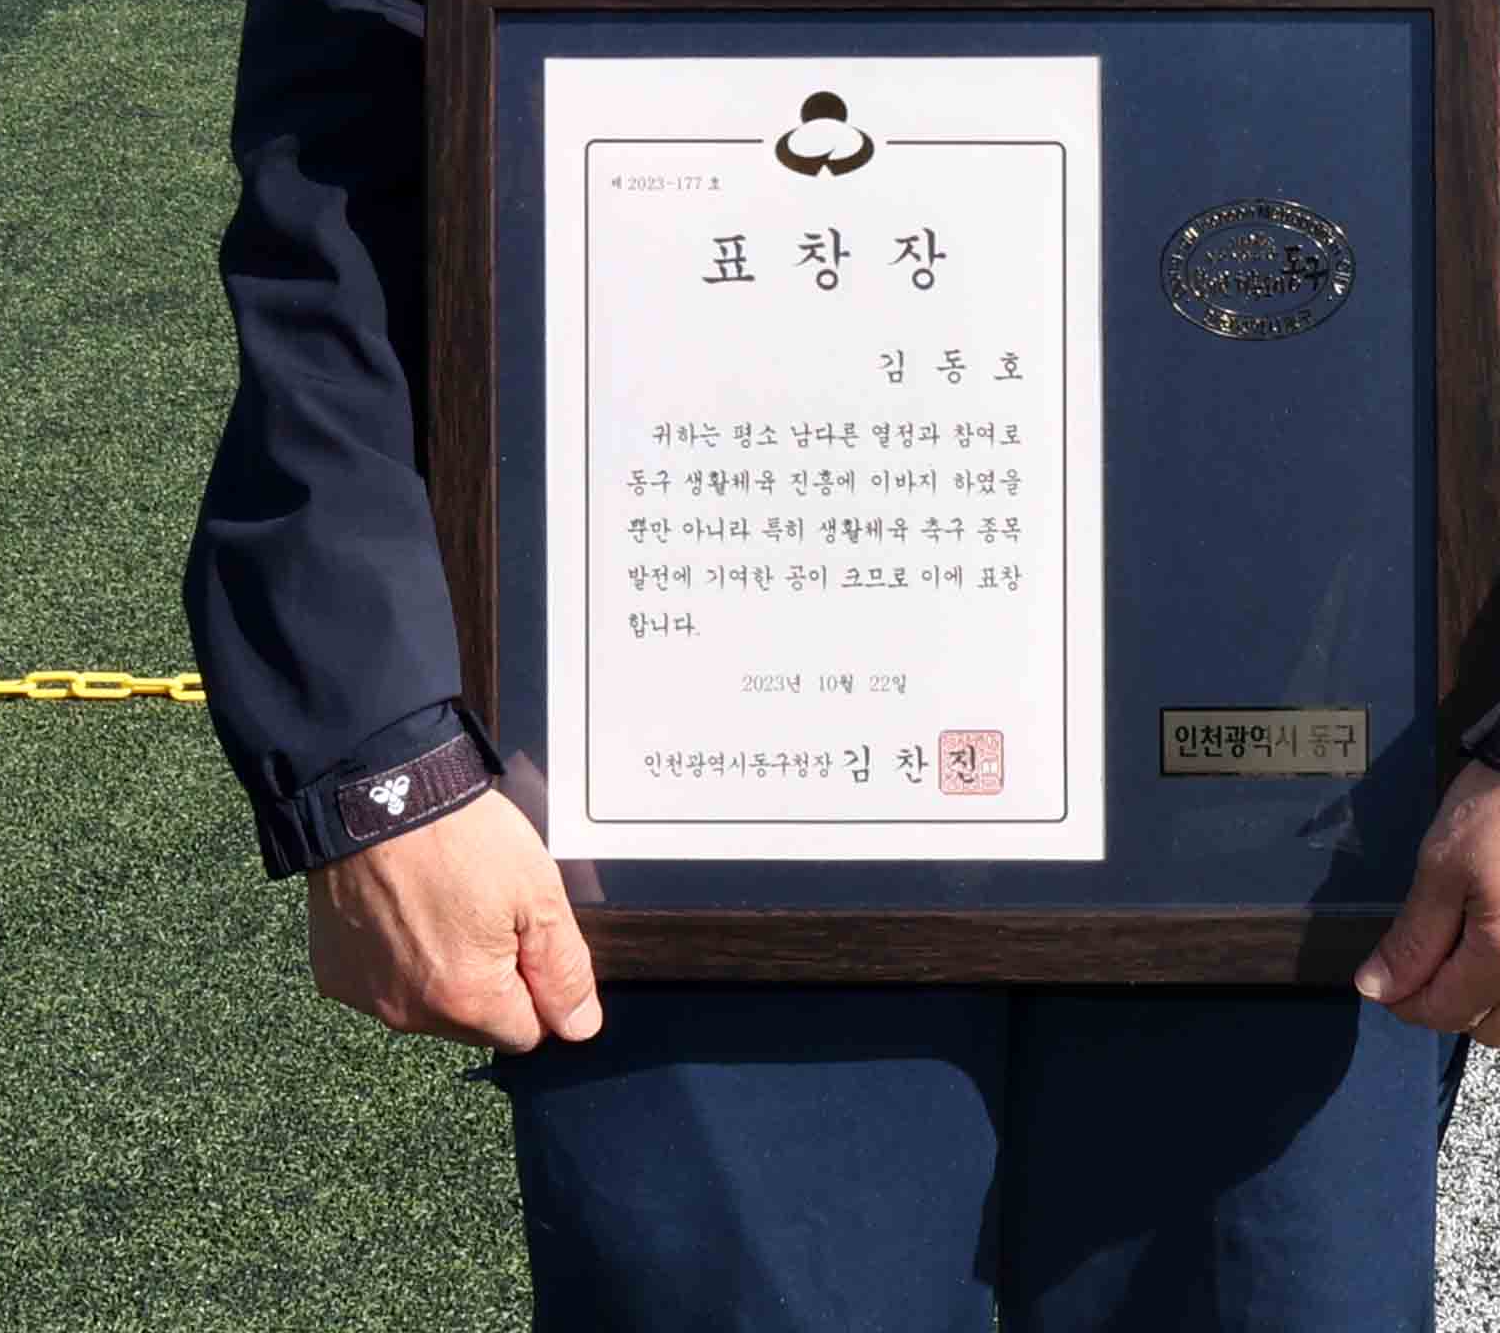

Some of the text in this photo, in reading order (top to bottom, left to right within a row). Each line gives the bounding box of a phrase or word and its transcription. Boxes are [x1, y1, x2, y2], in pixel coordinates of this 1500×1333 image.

[627, 176, 702, 191] 2023-177
[652, 422, 1021, 449] 귀하는 평소 남다른 열정과 참여로
[627, 469, 1021, 497] 동구 생활체육 진흥에 이바지 하였을
[627, 517, 1021, 544] 뿐만 아니라 특히 생활체육 축구 종목
[627, 565, 1021, 592] 발전에 기여한 공이 크므로 이에 표창
[742, 673, 907, 694] 2023년 10월 22일
[1174, 723, 1357, 758] 인천광역시 동구
[644, 751, 833, 779] 인천광역시동구청장
